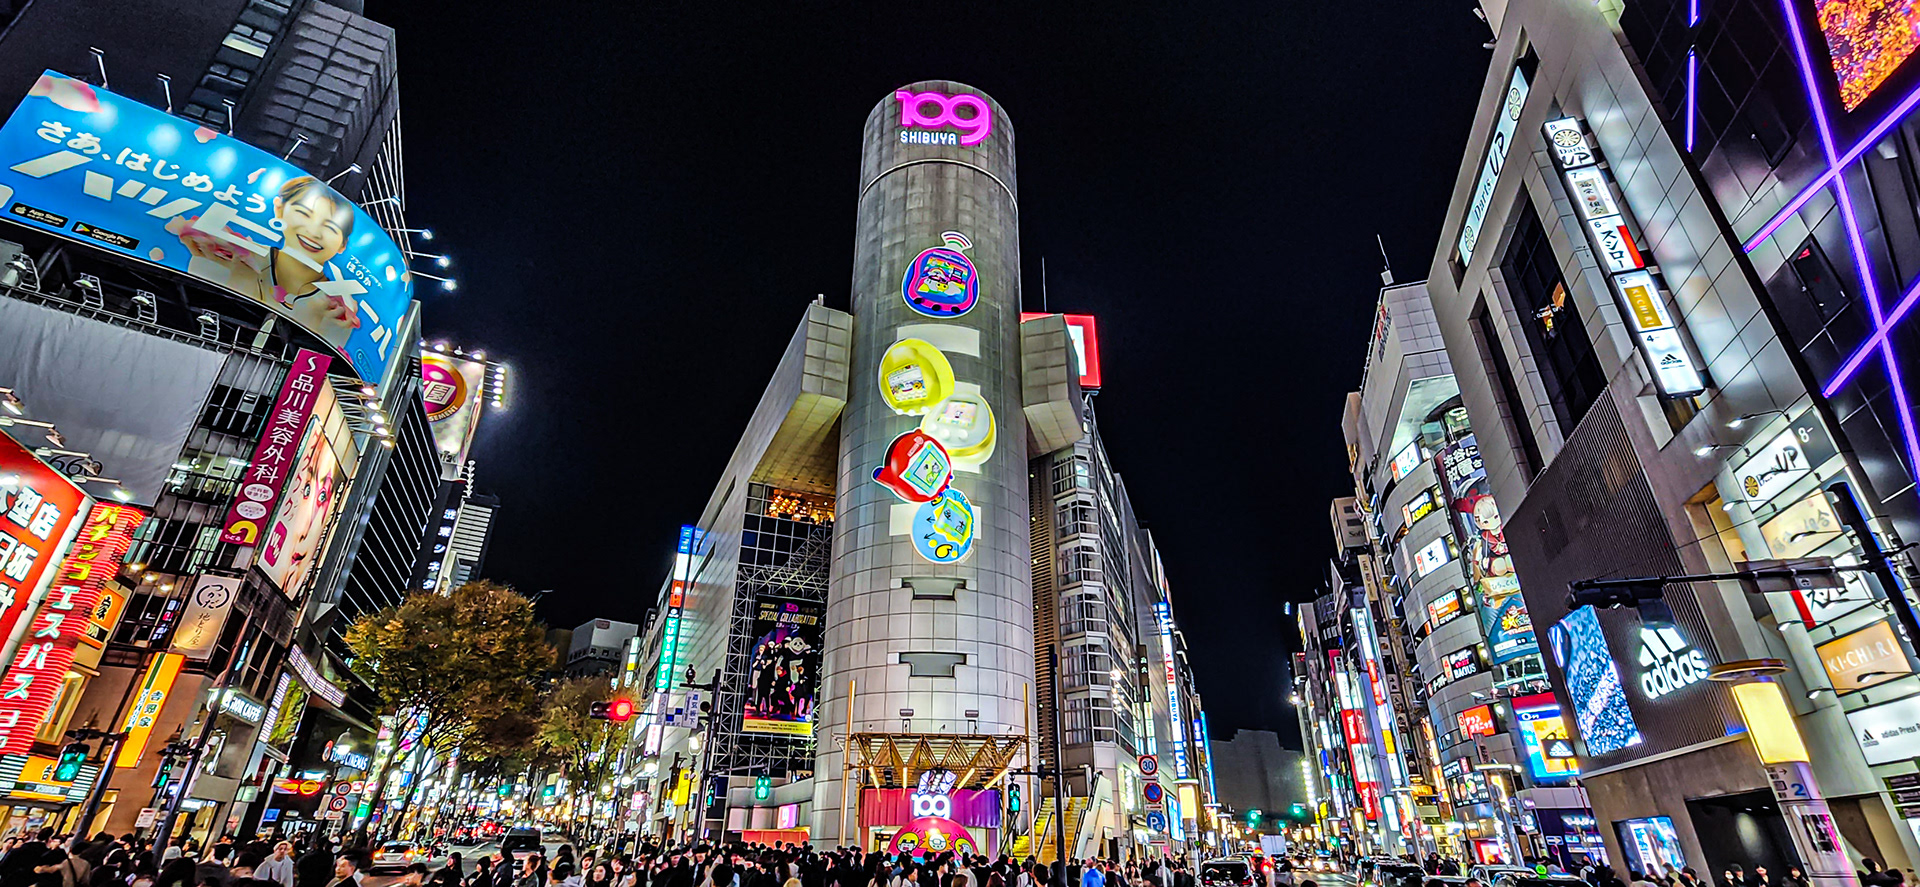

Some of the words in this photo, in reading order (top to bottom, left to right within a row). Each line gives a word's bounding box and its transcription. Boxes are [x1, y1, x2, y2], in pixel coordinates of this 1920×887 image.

[896, 89, 992, 145] 109
[900, 131, 957, 145] SHIBUYA
[1558, 147, 1586, 155] Darts
[1562, 152, 1591, 167] UP
[1474, 178, 1492, 222] Darts
[10, 150, 393, 360] ハッピーメール
[1601, 230, 1626, 270] スシロー
[346, 261, 372, 287] ほのか
[253, 373, 317, 485] 品川美容外科
[1443, 446, 1478, 469] 渋谷に
[1165, 660, 1175, 685] LABI
[1641, 650, 1709, 700] adidas
[1169, 690, 1178, 722] SHIBUYA
[1142, 760, 1153, 771] 30
[1175, 752, 1187, 778] LABI
[1791, 783, 1807, 796] 2
[911, 794, 951, 820] 109
